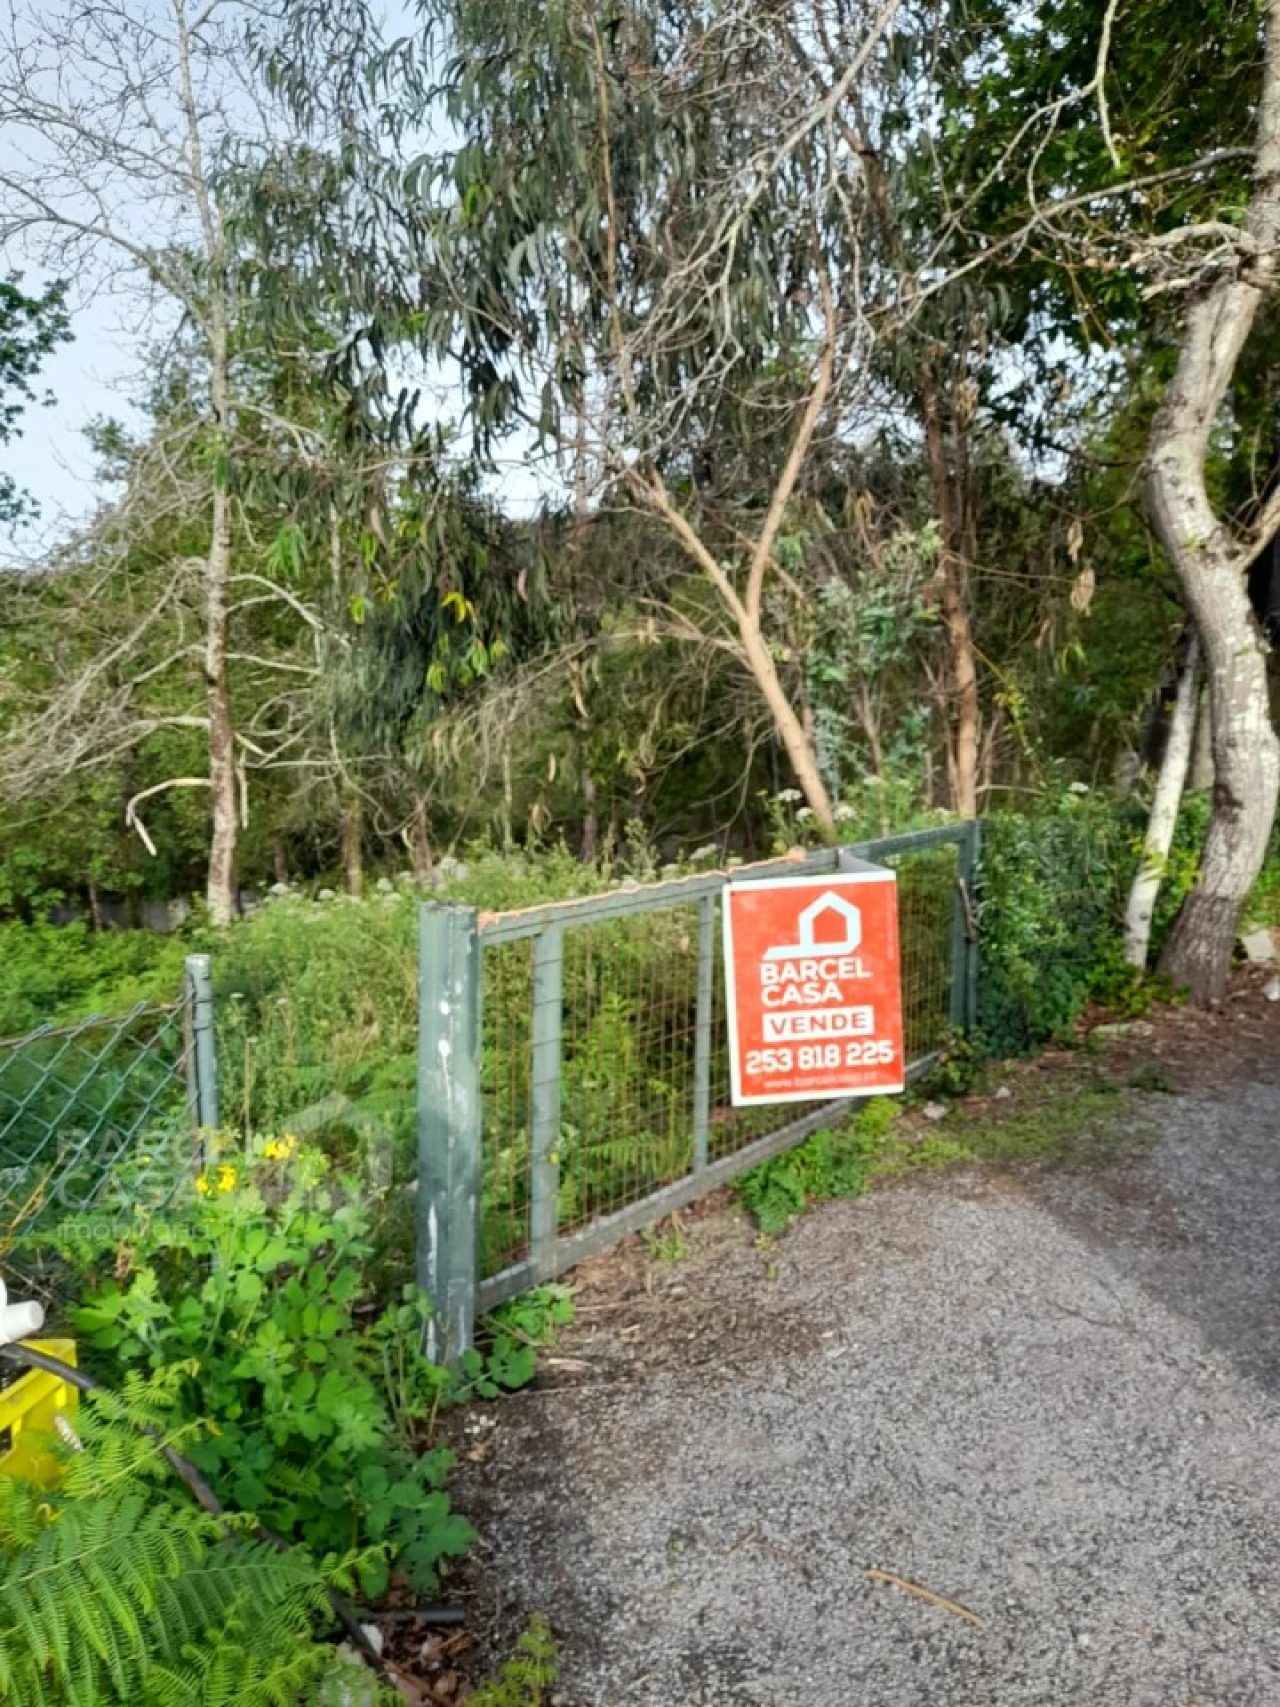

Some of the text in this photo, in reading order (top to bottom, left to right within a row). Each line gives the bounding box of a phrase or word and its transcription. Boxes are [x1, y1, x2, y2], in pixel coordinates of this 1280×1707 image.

[760, 957, 871, 985] BARCEL
[761, 983, 843, 1007] CASA
[770, 1011, 867, 1035] VENDE
[745, 1039, 894, 1075] 253 818 225
